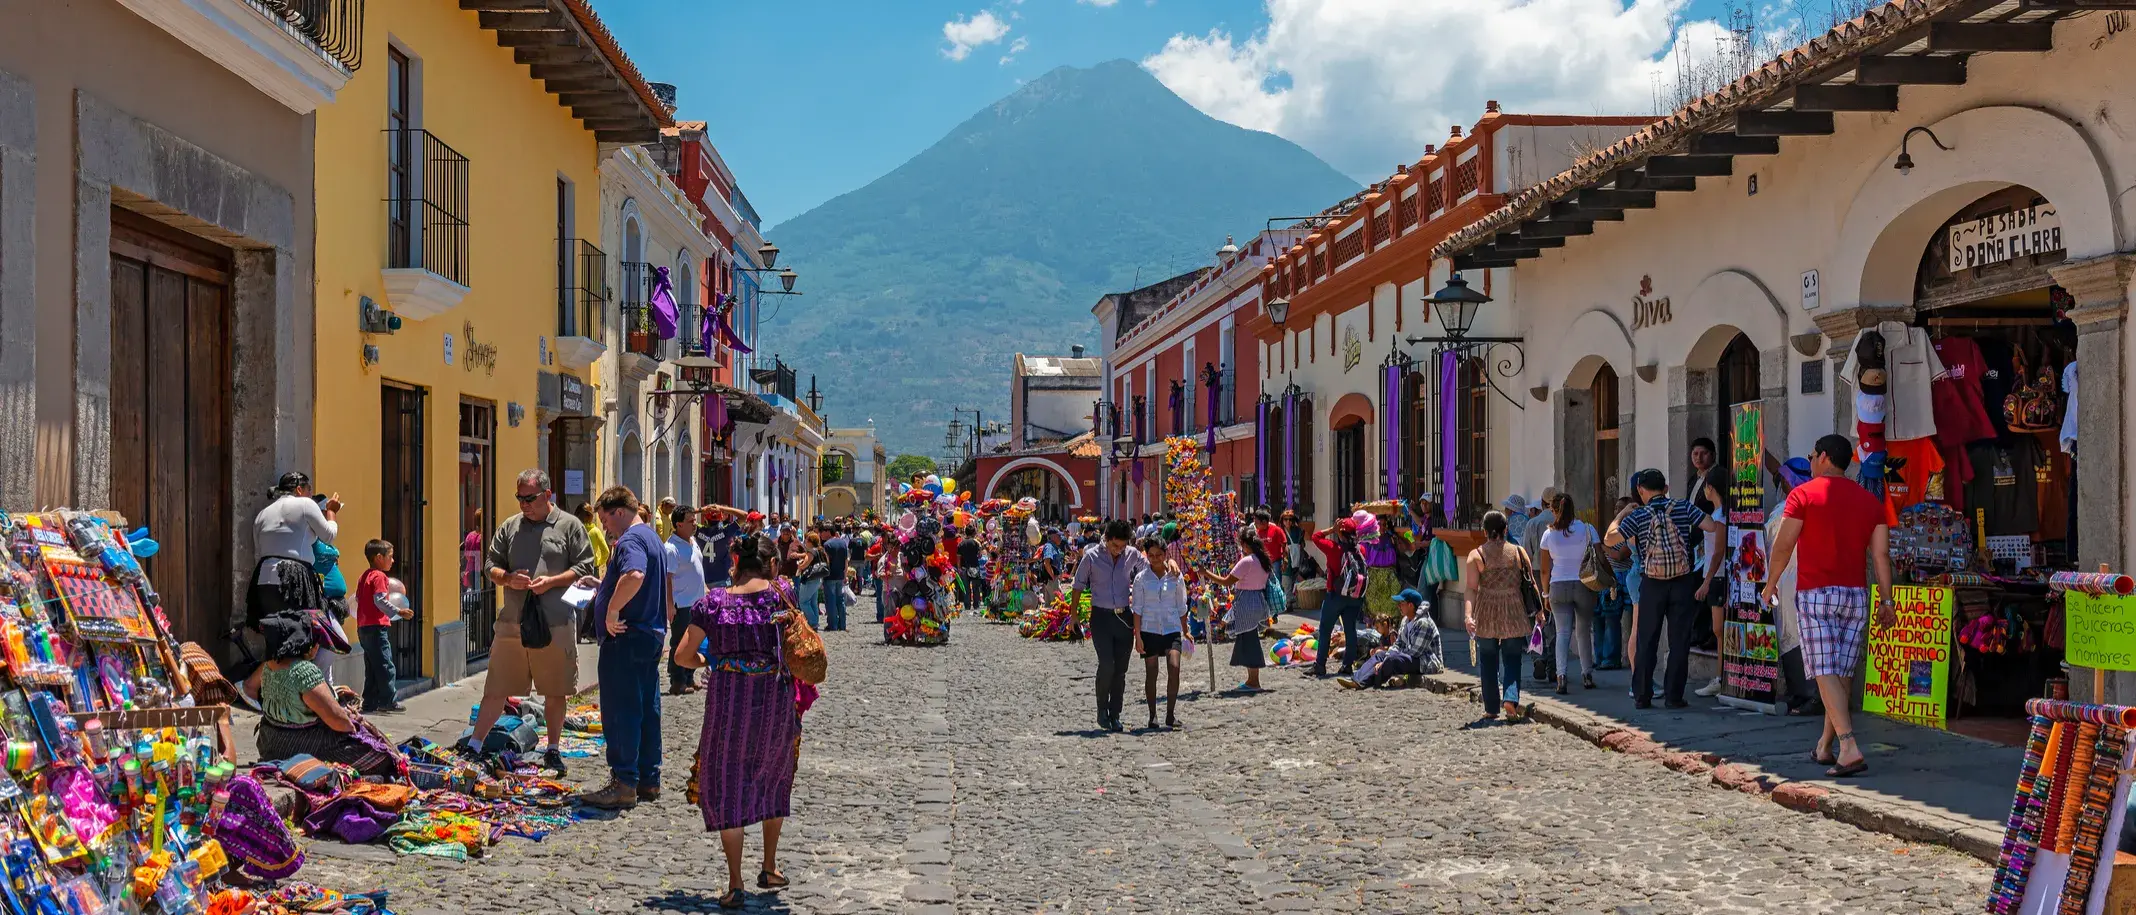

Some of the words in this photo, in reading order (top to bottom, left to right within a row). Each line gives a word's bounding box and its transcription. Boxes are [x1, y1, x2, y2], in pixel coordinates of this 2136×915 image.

[1966, 234, 2005, 267] DOÑA
[2009, 226, 2061, 259] CLARA
[1631, 295, 1672, 331] Diva
[702, 540, 716, 563] 4
[1875, 585, 1922, 600] SUTTLE
[1926, 587, 1944, 602] TO
[1874, 601, 1945, 616] PAJACHEL
[2068, 595, 2081, 612] Se
[2085, 598, 2124, 615] hacen
[1894, 615, 1949, 632] MARCOS
[1869, 628, 1891, 642] SAN
[1892, 629, 1933, 645] PEDRO
[1934, 631, 1948, 645] LL
[1868, 643, 1946, 662] MONTERRICO
[2074, 647, 2132, 666] nombres
[1874, 657, 1909, 673] CHICHI
[1879, 670, 1906, 686] TIKAL
[1866, 683, 1907, 700] PRIVATE
[1885, 700, 1940, 717] SHUTTLE
